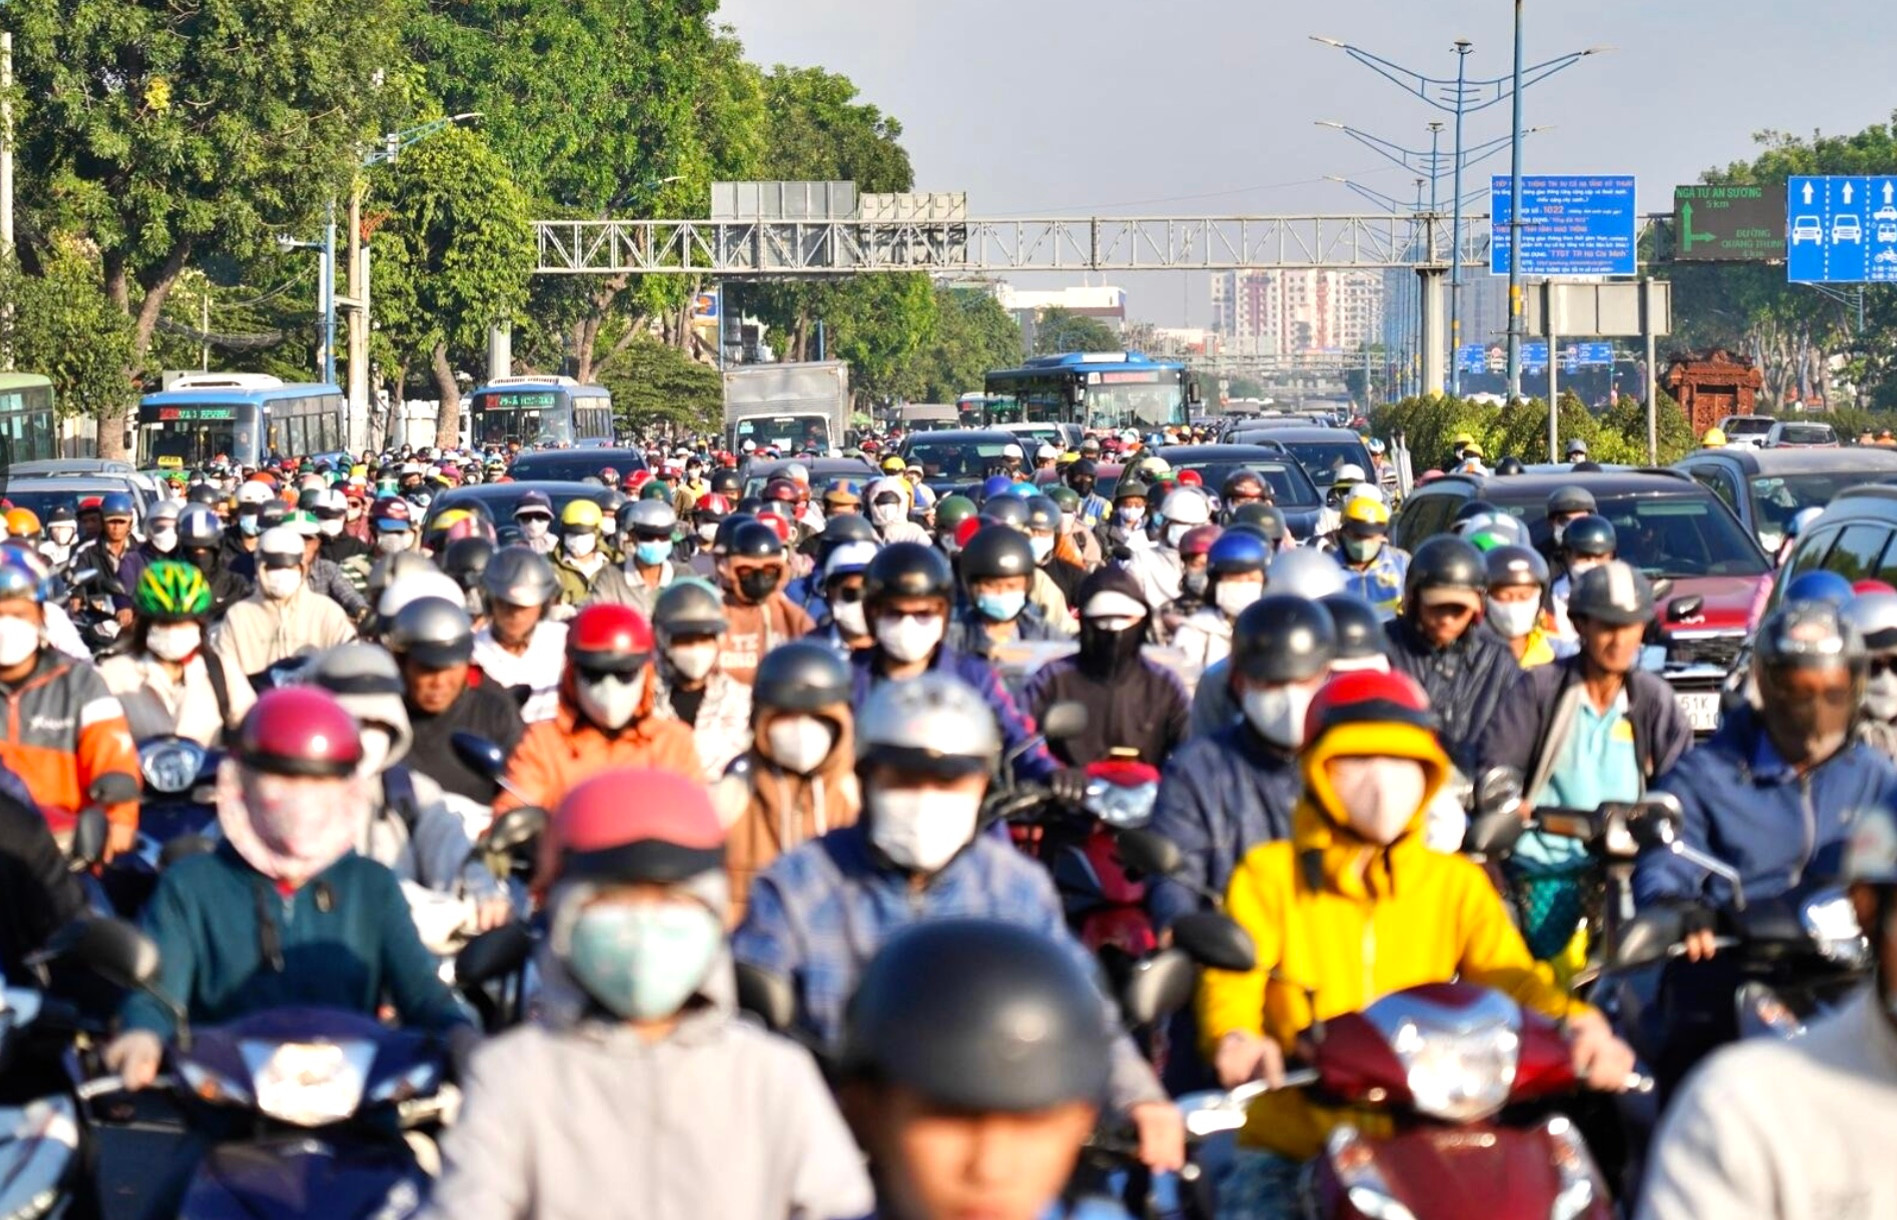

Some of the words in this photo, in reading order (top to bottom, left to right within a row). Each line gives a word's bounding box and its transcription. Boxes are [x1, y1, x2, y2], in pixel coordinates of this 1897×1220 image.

[1712, 187, 1725, 198] AN
[1727, 187, 1762, 198] SƯƠNG
[1680, 696, 1708, 710] 51K
